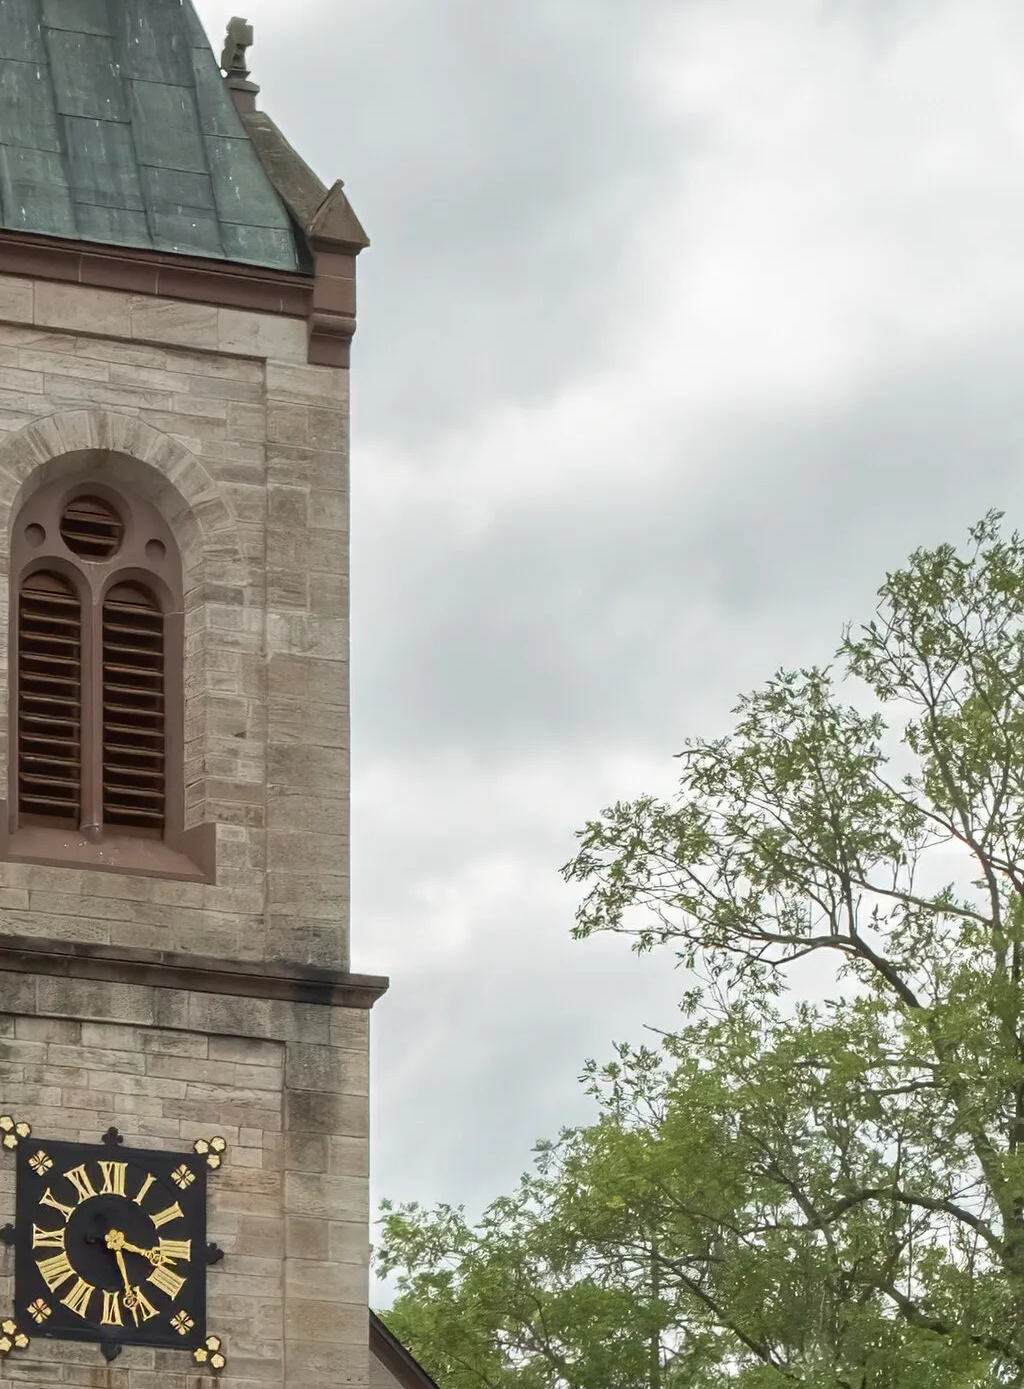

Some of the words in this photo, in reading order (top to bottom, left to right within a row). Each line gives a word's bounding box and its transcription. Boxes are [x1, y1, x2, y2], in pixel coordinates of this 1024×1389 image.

[62, 1163, 99, 1204] XI
[97, 1161, 128, 1197] XII
[132, 1172, 158, 1206] I
[39, 1187, 76, 1223] X
[149, 1201, 184, 1229] II
[32, 1223, 66, 1250] IX
[158, 1236, 192, 1262] III
[35, 1251, 77, 1293] VIII
[60, 1276, 96, 1318] VII
[100, 1289, 124, 1327] VI
